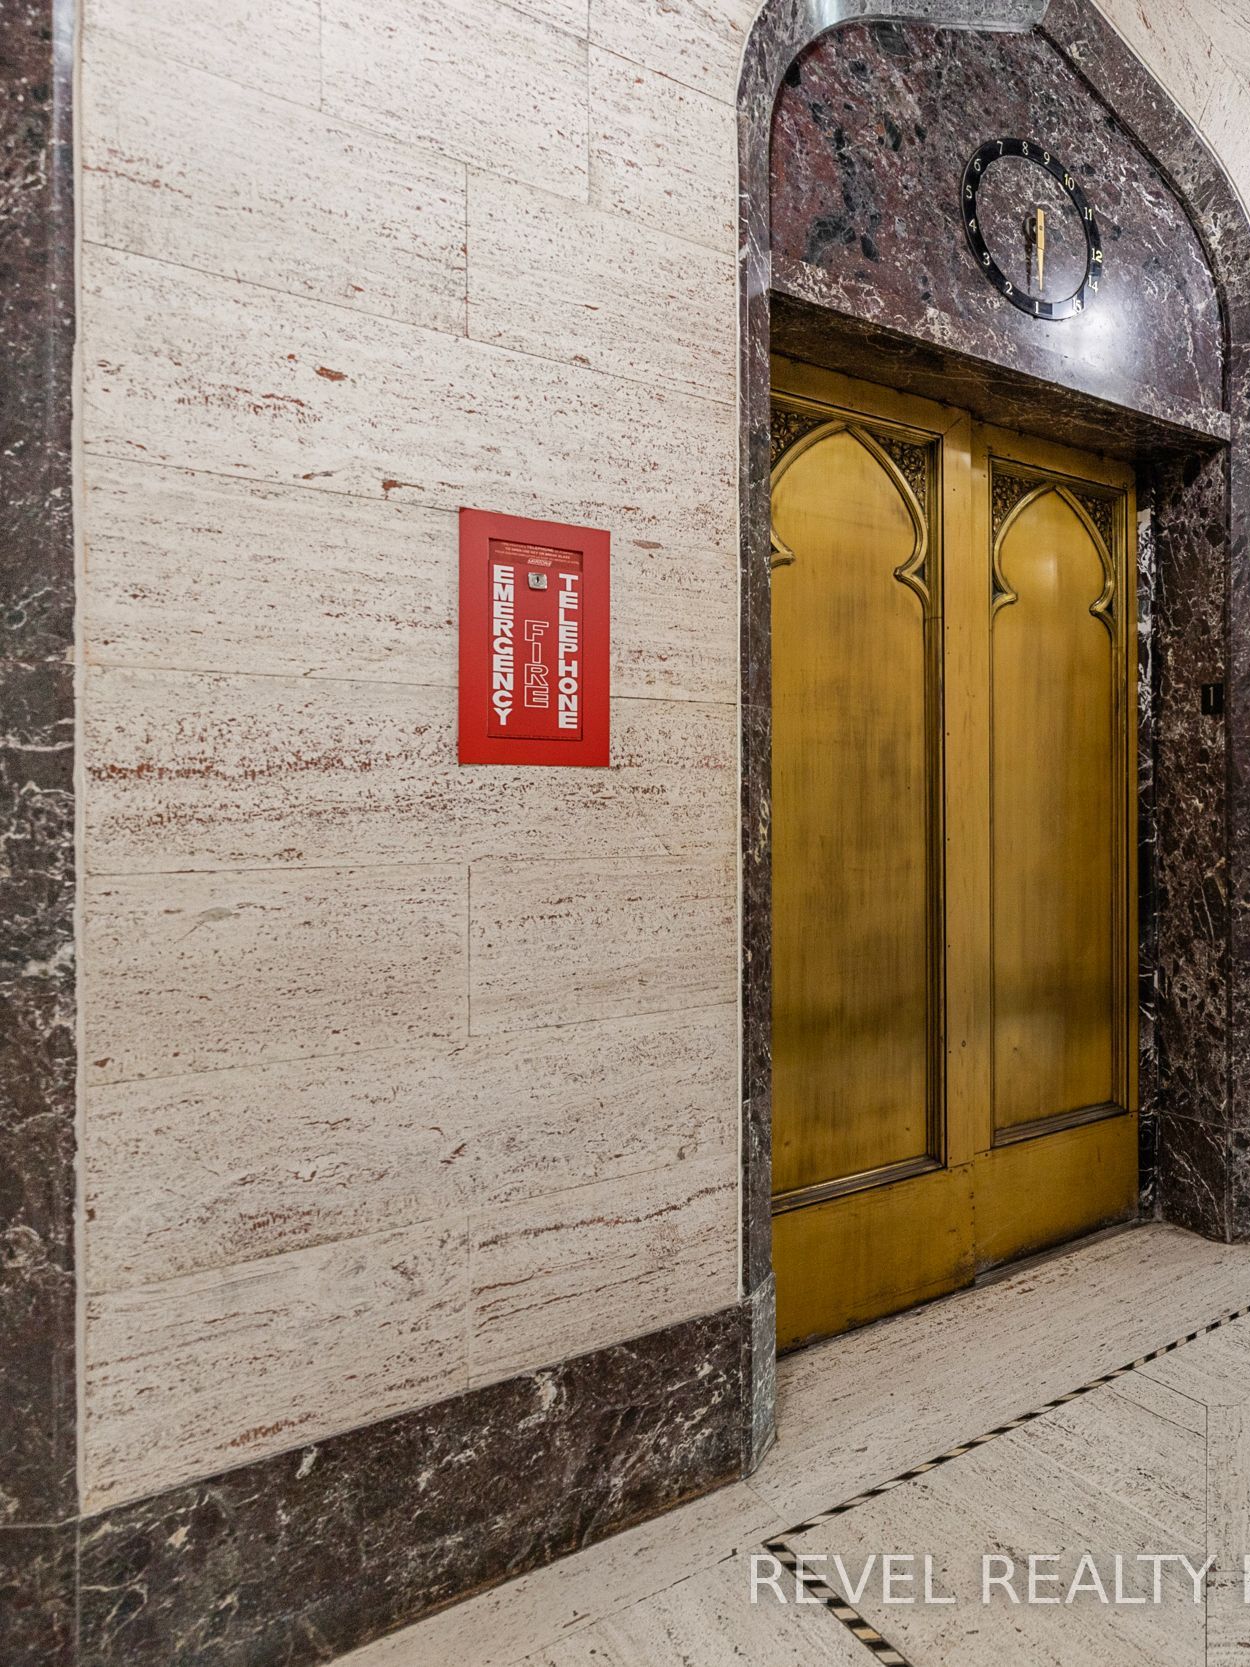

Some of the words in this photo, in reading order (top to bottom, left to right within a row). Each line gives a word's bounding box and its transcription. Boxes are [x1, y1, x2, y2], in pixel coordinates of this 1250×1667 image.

[996, 141, 1004, 155] 7
[1022, 141, 1029, 155] 8
[974, 158, 982, 171] 6
[1044, 152, 1050, 165] 9
[1064, 173, 1075, 191] 10
[965, 185, 973, 199] 5
[1084, 206, 1093, 221] 11
[968, 218, 977, 231] 4
[983, 252, 990, 266] 3
[1091, 248, 1103, 263] 12
[1005, 281, 1013, 295] 2
[1088, 274, 1098, 294] 14
[1034, 301, 1039, 314] 1
[492, 565, 514, 725] EMERGENCY
[558, 573, 579, 729] TELEPHONE
[524, 620, 549, 709] FIRE
[1209, 686, 1214, 706] 1
